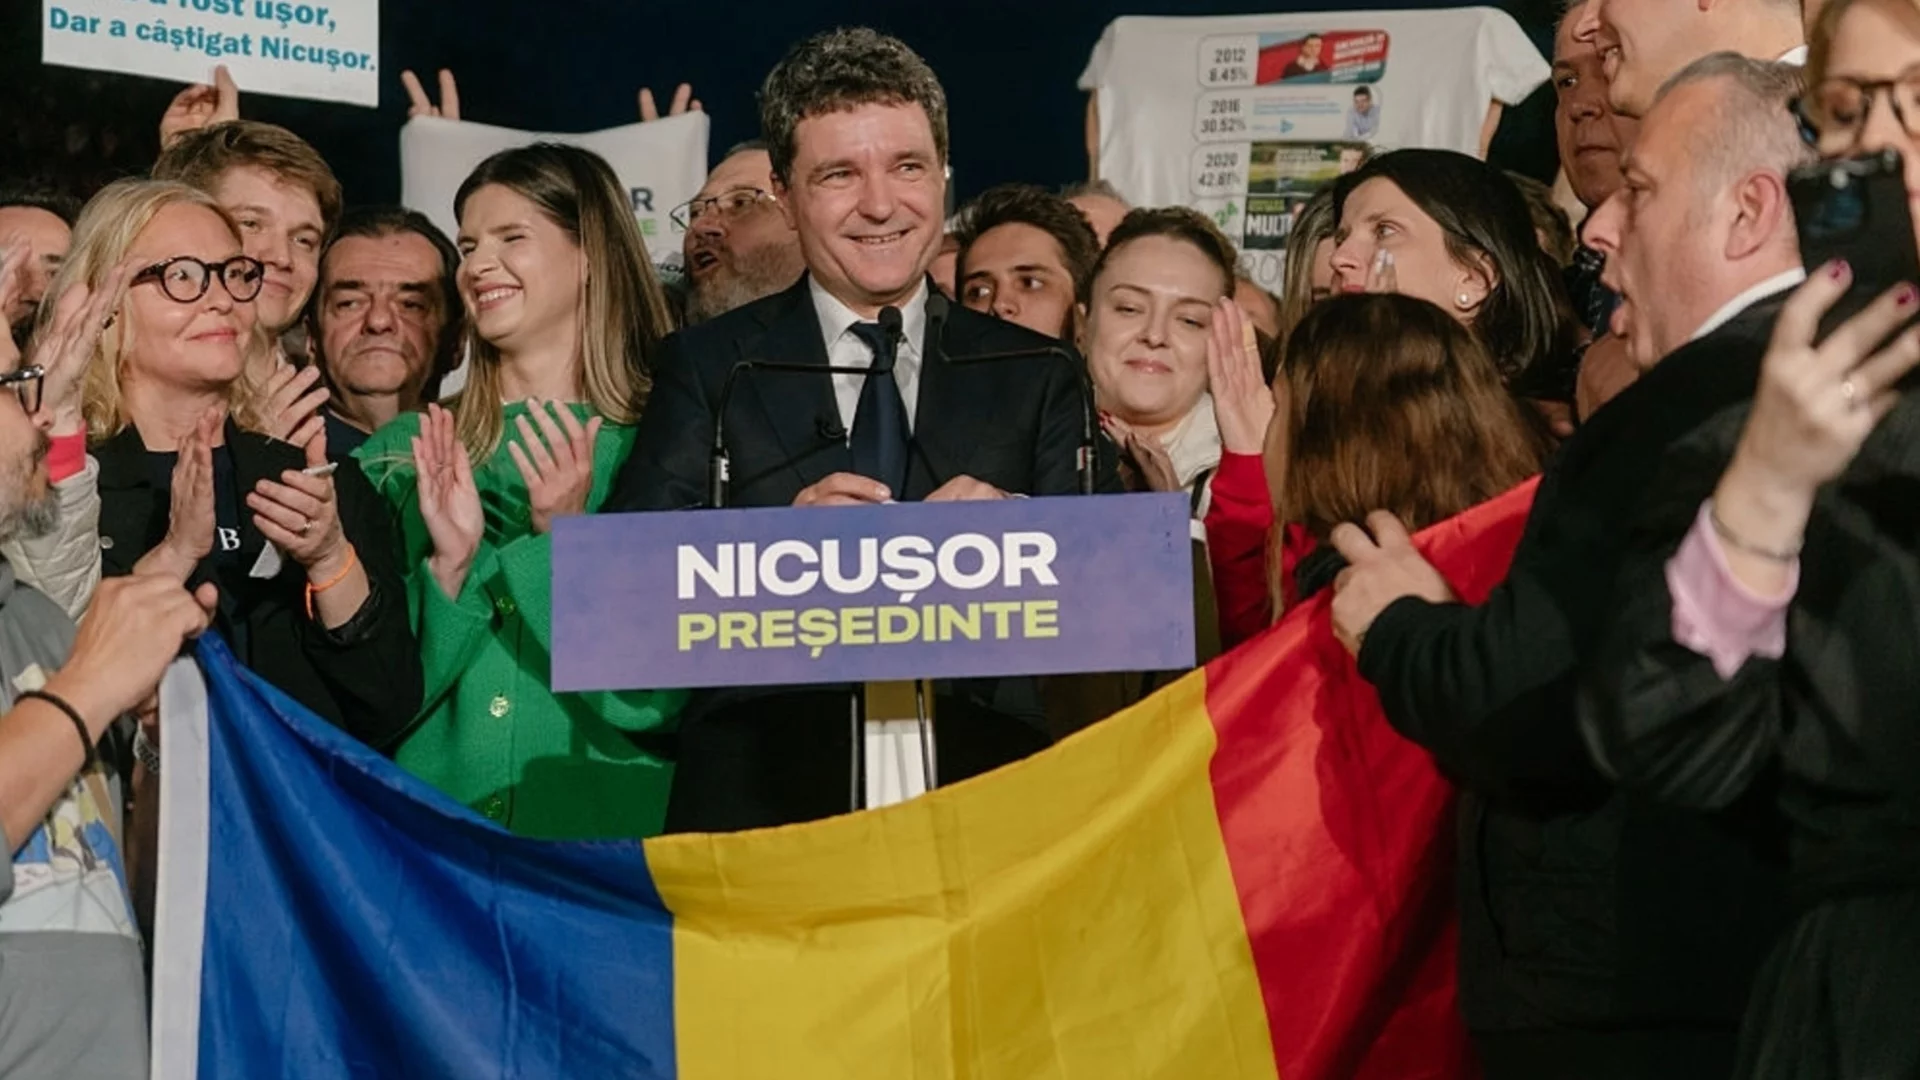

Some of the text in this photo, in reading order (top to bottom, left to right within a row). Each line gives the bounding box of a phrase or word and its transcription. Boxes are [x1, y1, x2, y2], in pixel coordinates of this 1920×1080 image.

[254, 0, 336, 33] ușor,
[50, 6, 375, 72] Dar a câștigat Nicușor.
[1214, 48, 1246, 64] 2012
[1211, 99, 1240, 114] 2016
[1205, 152, 1238, 168] 2020
[677, 531, 1059, 604] NICUȘOR
[677, 600, 1059, 659] PREȘEDINTE
